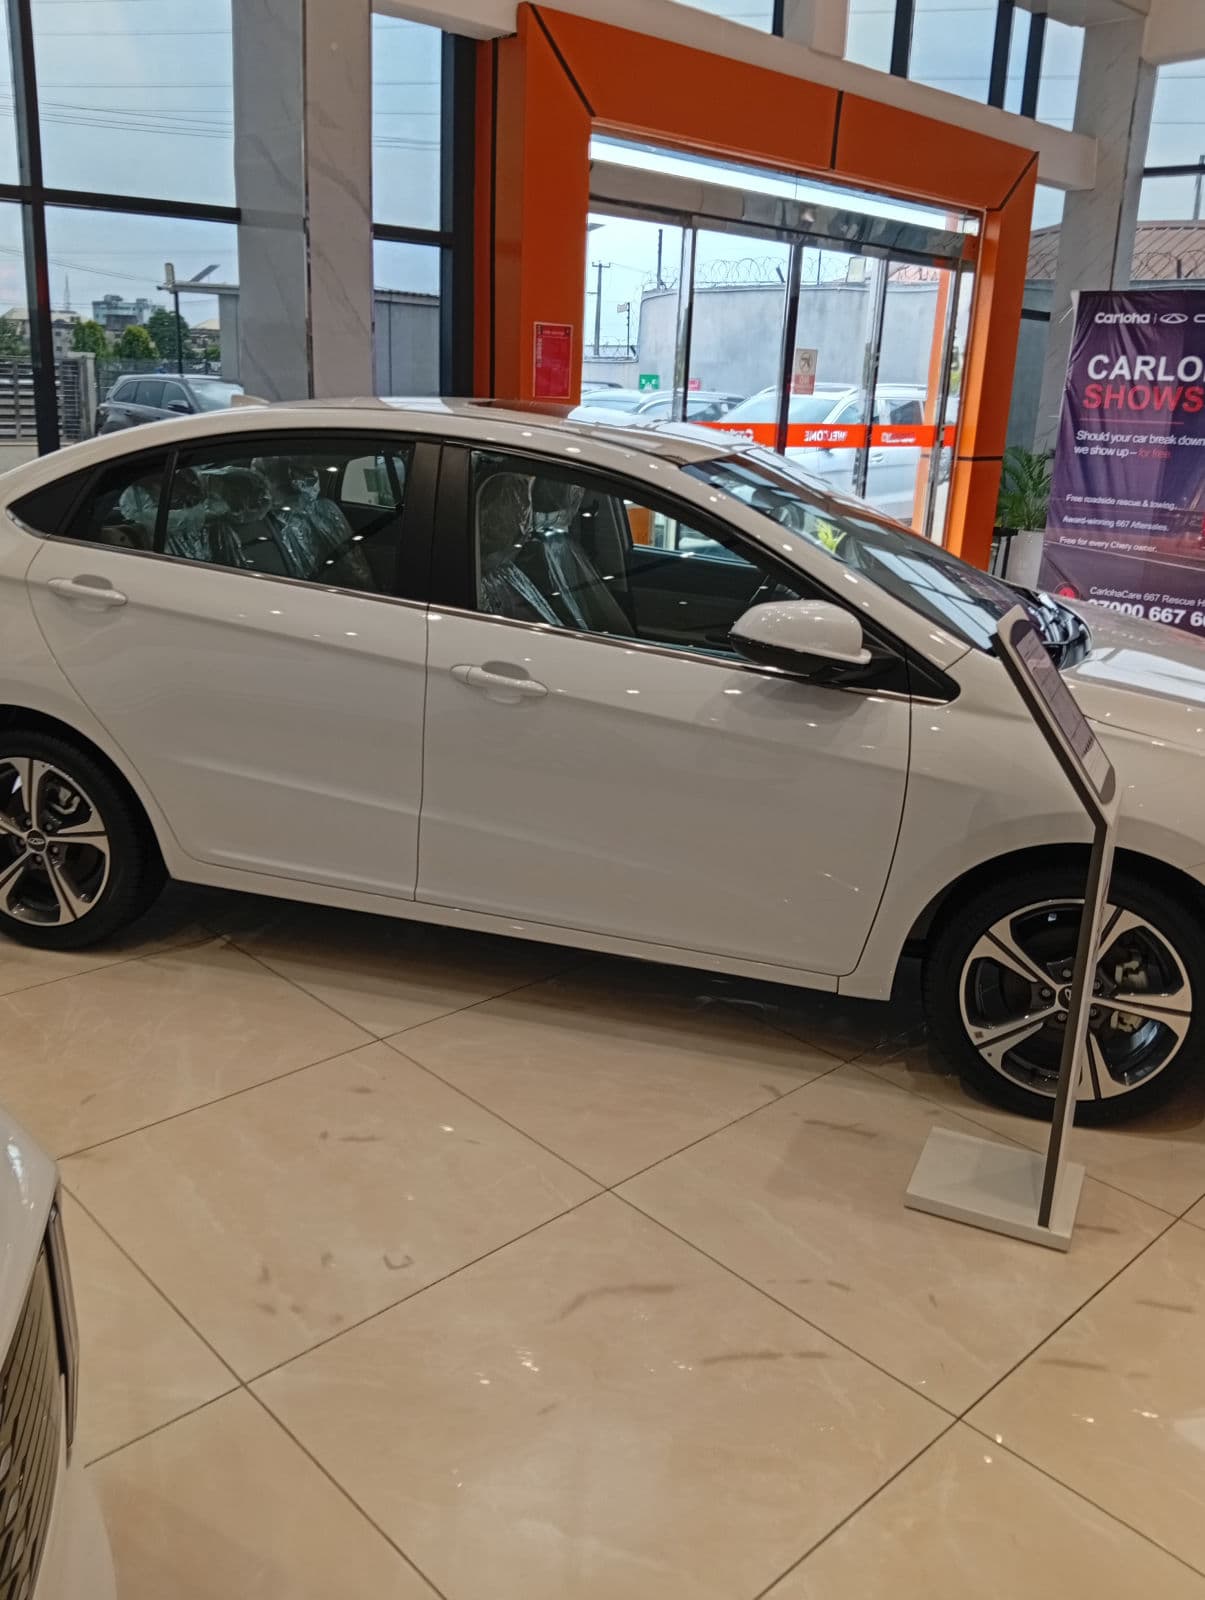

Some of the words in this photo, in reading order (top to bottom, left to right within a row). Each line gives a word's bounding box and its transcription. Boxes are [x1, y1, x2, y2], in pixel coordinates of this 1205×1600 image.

[1094, 312, 1151, 325] Carloha
[1087, 354, 1205, 382] CARLO
[1075, 430, 1110, 441] Should
[1110, 433, 1132, 444] your
[1132, 434, 1148, 444] car
[1148, 434, 1177, 445] break
[1073, 445, 1089, 455] we
[1089, 445, 1115, 456] show
[1115, 447, 1130, 458] up
[1137, 447, 1151, 457] for
[1065, 494, 1084, 503] Free
[1083, 495, 1116, 505] roadside
[1116, 498, 1141, 507] rescue
[1142, 500, 1149, 508] &
[1062, 516, 1114, 528] Award-winning
[1059, 536, 1077, 545] Free
[1077, 537, 1088, 546] for
[1088, 540, 1110, 549] every
[1109, 541, 1133, 552] Chery
[1132, 545, 1158, 553] owner.
[1089, 586, 1142, 601] CarlohaCare
[1143, 592, 1161, 602] 667
[1162, 595, 1197, 607] Rescue
[1148, 606, 1186, 624] 667
